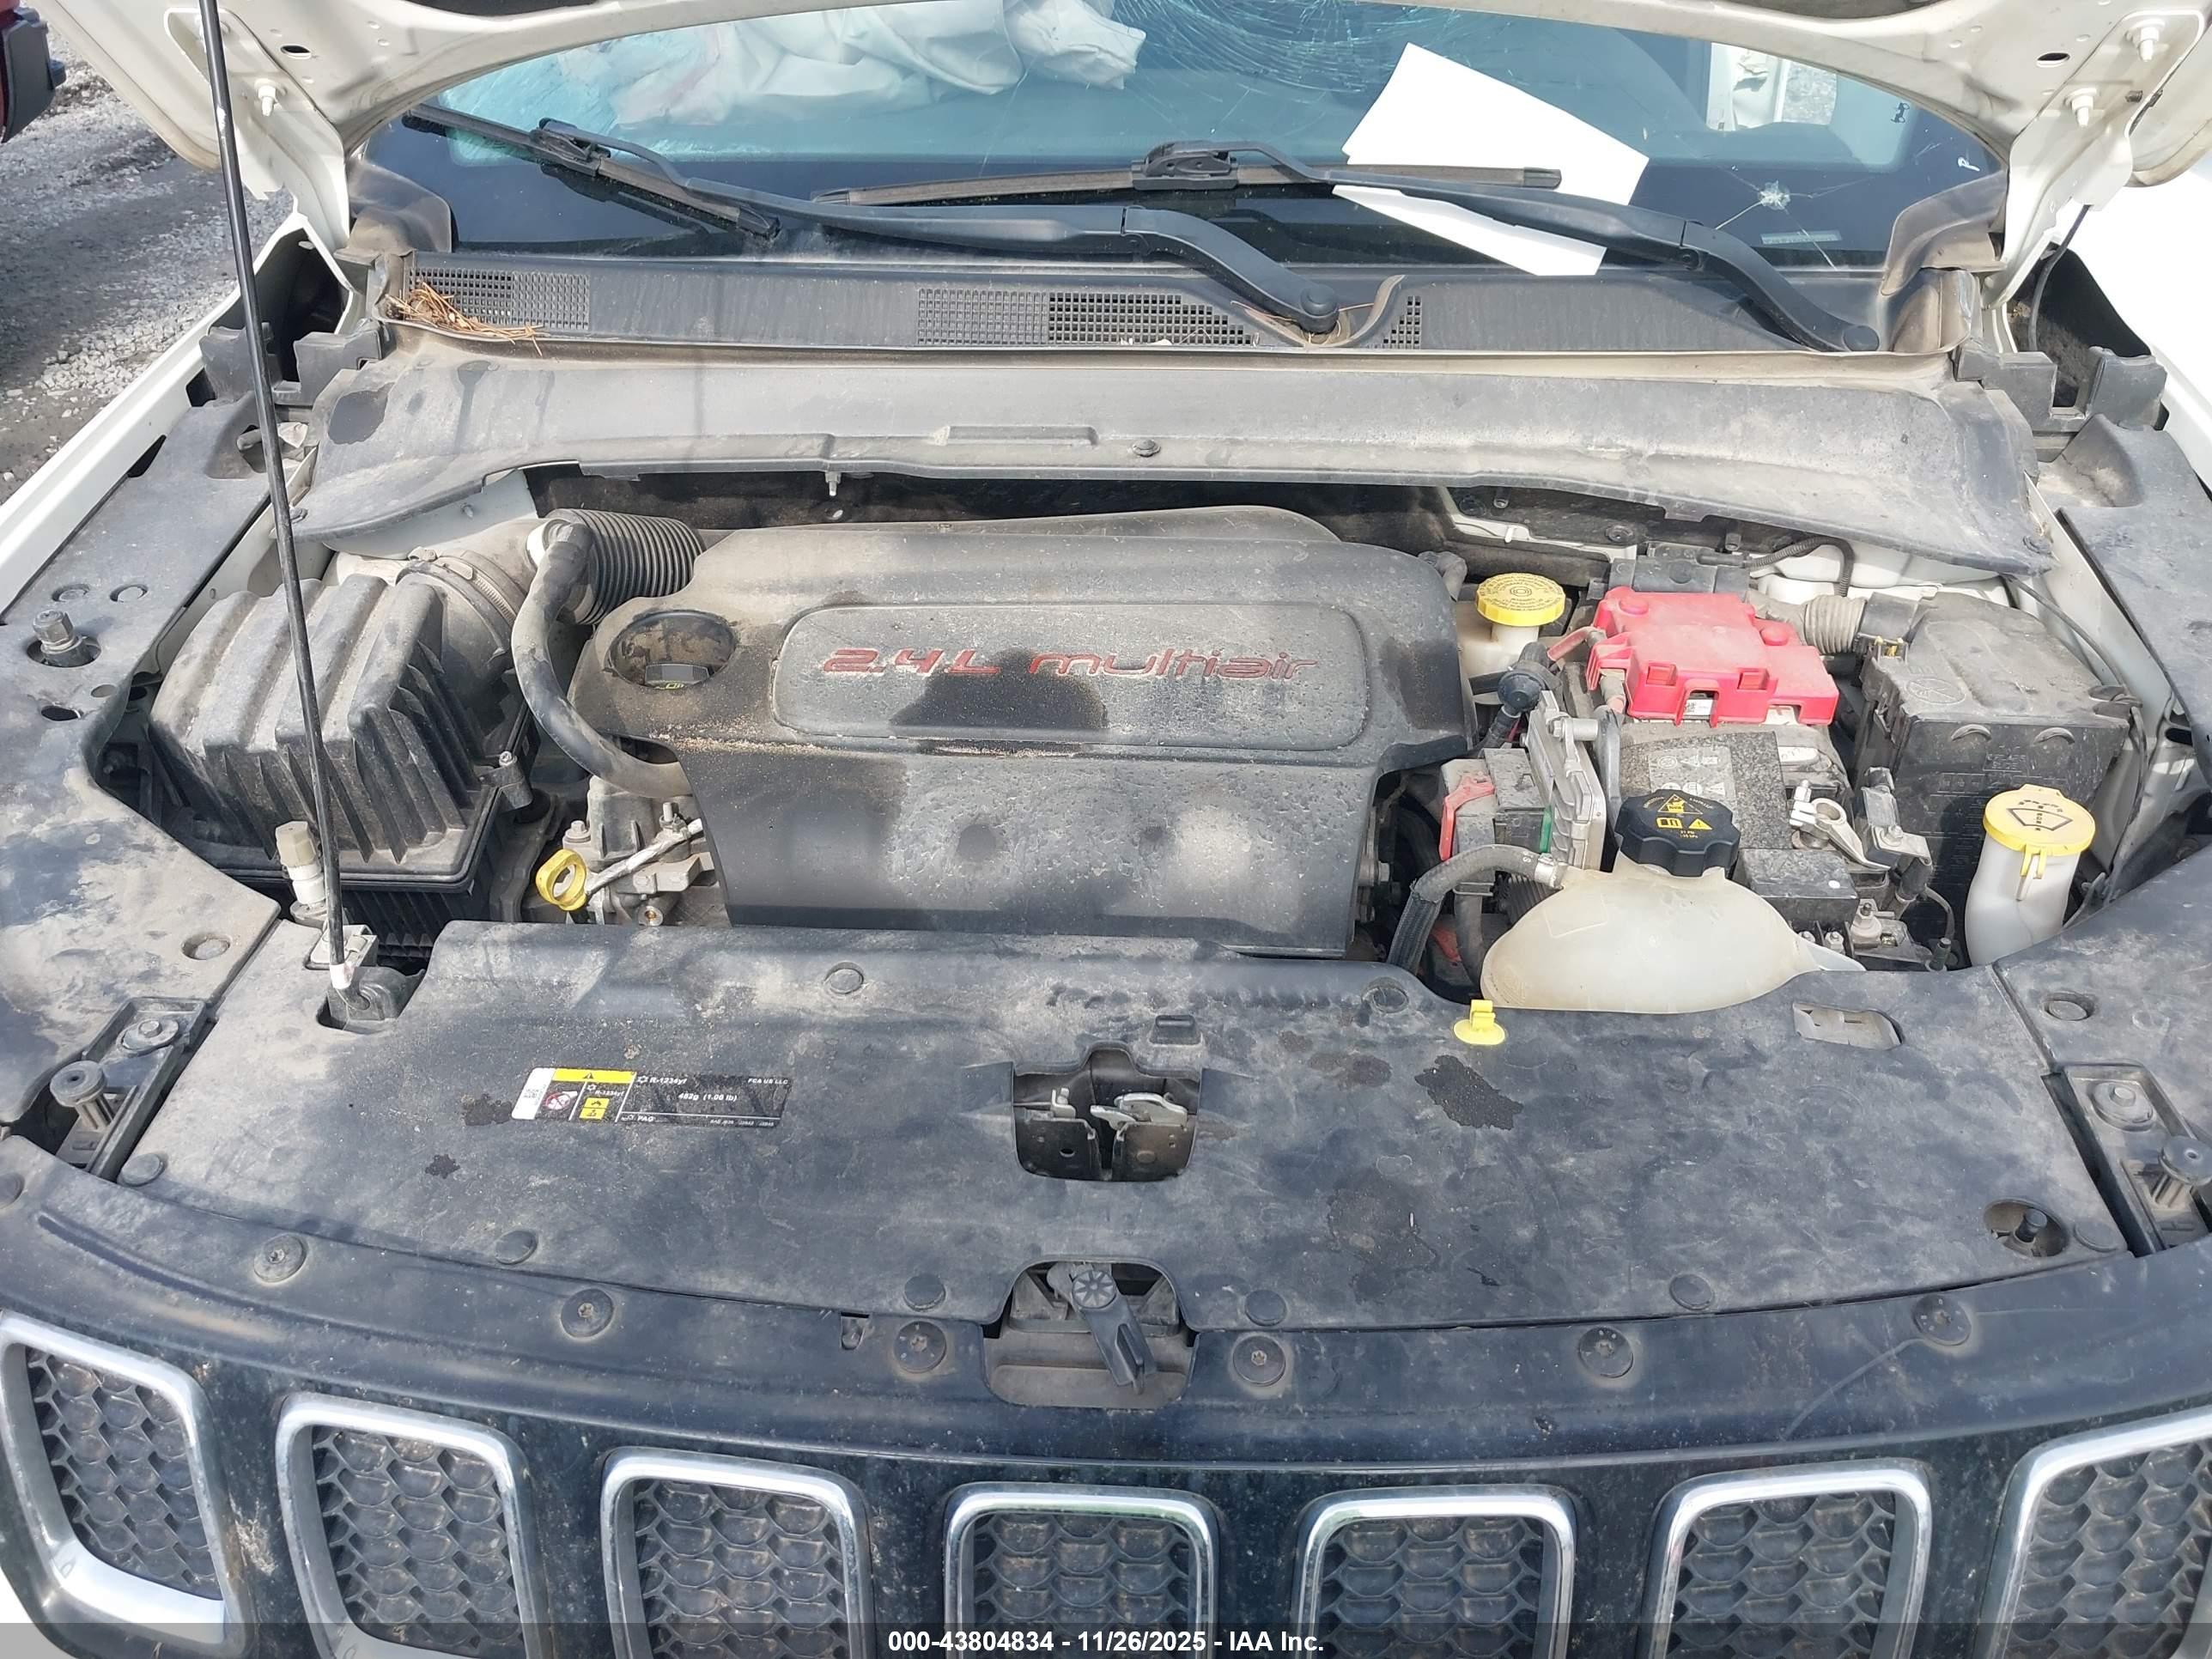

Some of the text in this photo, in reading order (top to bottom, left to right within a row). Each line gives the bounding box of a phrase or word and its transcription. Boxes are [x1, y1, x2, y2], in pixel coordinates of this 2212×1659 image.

[823, 647, 1318, 680] 2.4L multiair
[649, 1077, 688, 1085] R-1234yf
